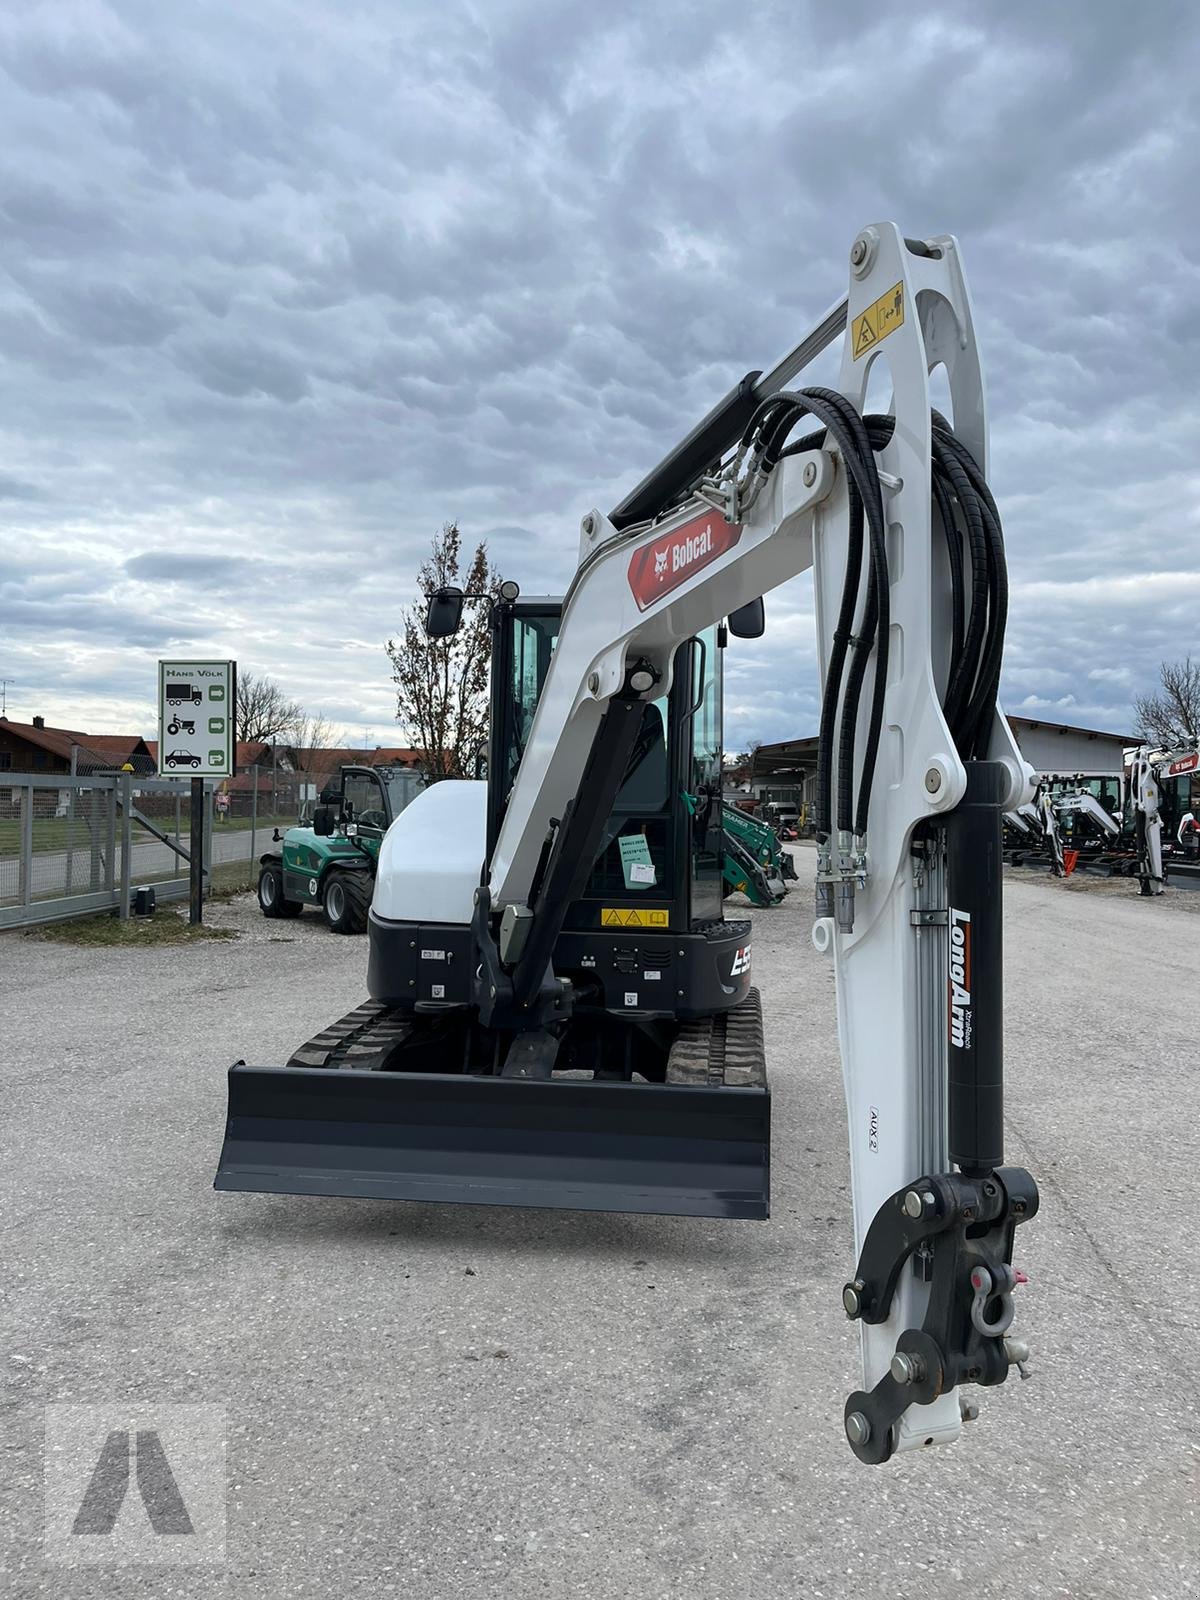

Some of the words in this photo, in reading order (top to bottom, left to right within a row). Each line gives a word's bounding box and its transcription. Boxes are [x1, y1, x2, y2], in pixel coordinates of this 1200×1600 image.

[672, 524, 712, 573] Bobcat
[950, 907, 971, 1048] LongArm
[965, 1010, 973, 1049] XtraReach
[870, 1111, 878, 1138] AUX
[869, 1140, 877, 1149] 2
